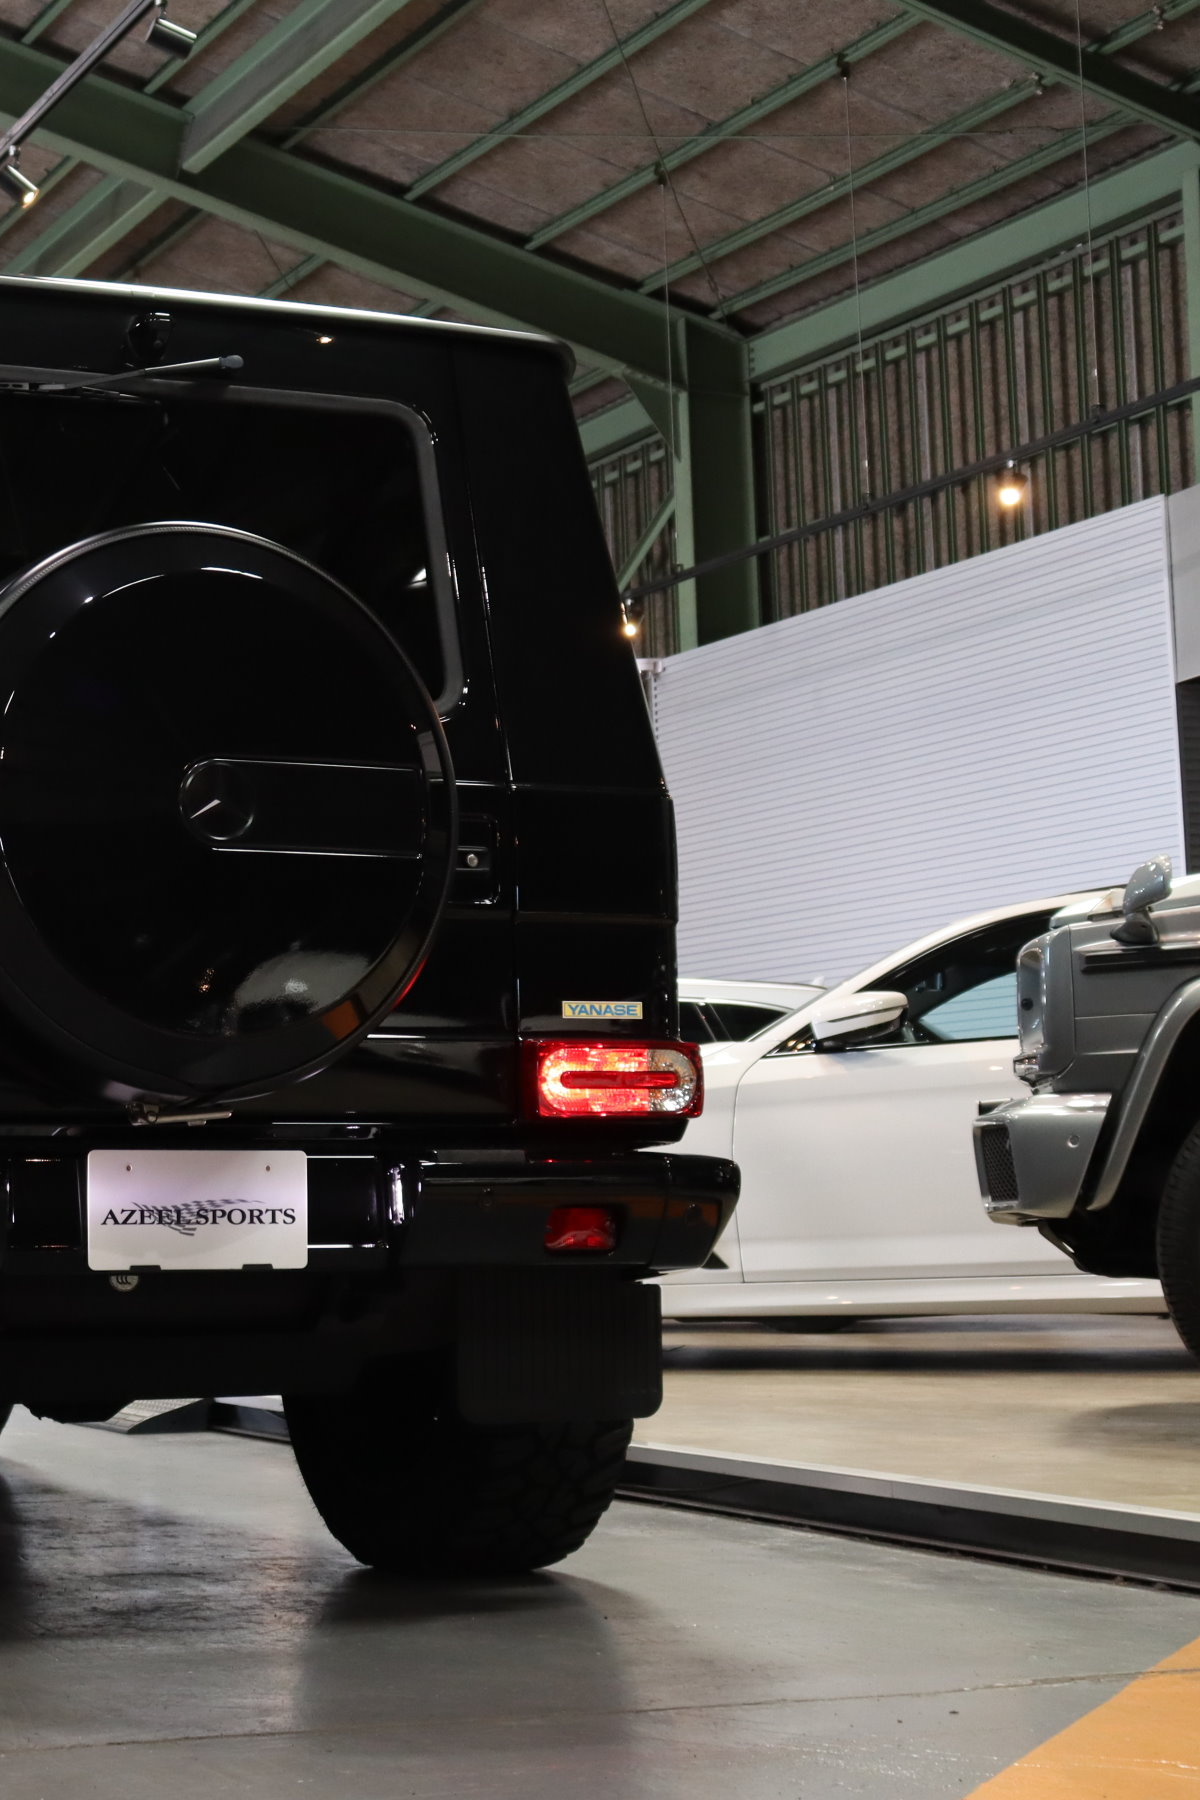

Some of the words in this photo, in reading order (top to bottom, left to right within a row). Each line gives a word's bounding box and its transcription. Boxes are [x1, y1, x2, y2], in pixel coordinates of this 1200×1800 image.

[568, 1004, 638, 1016] YANASE
[101, 1208, 190, 1225] AZEEL
[195, 1208, 296, 1225] SPORTS
